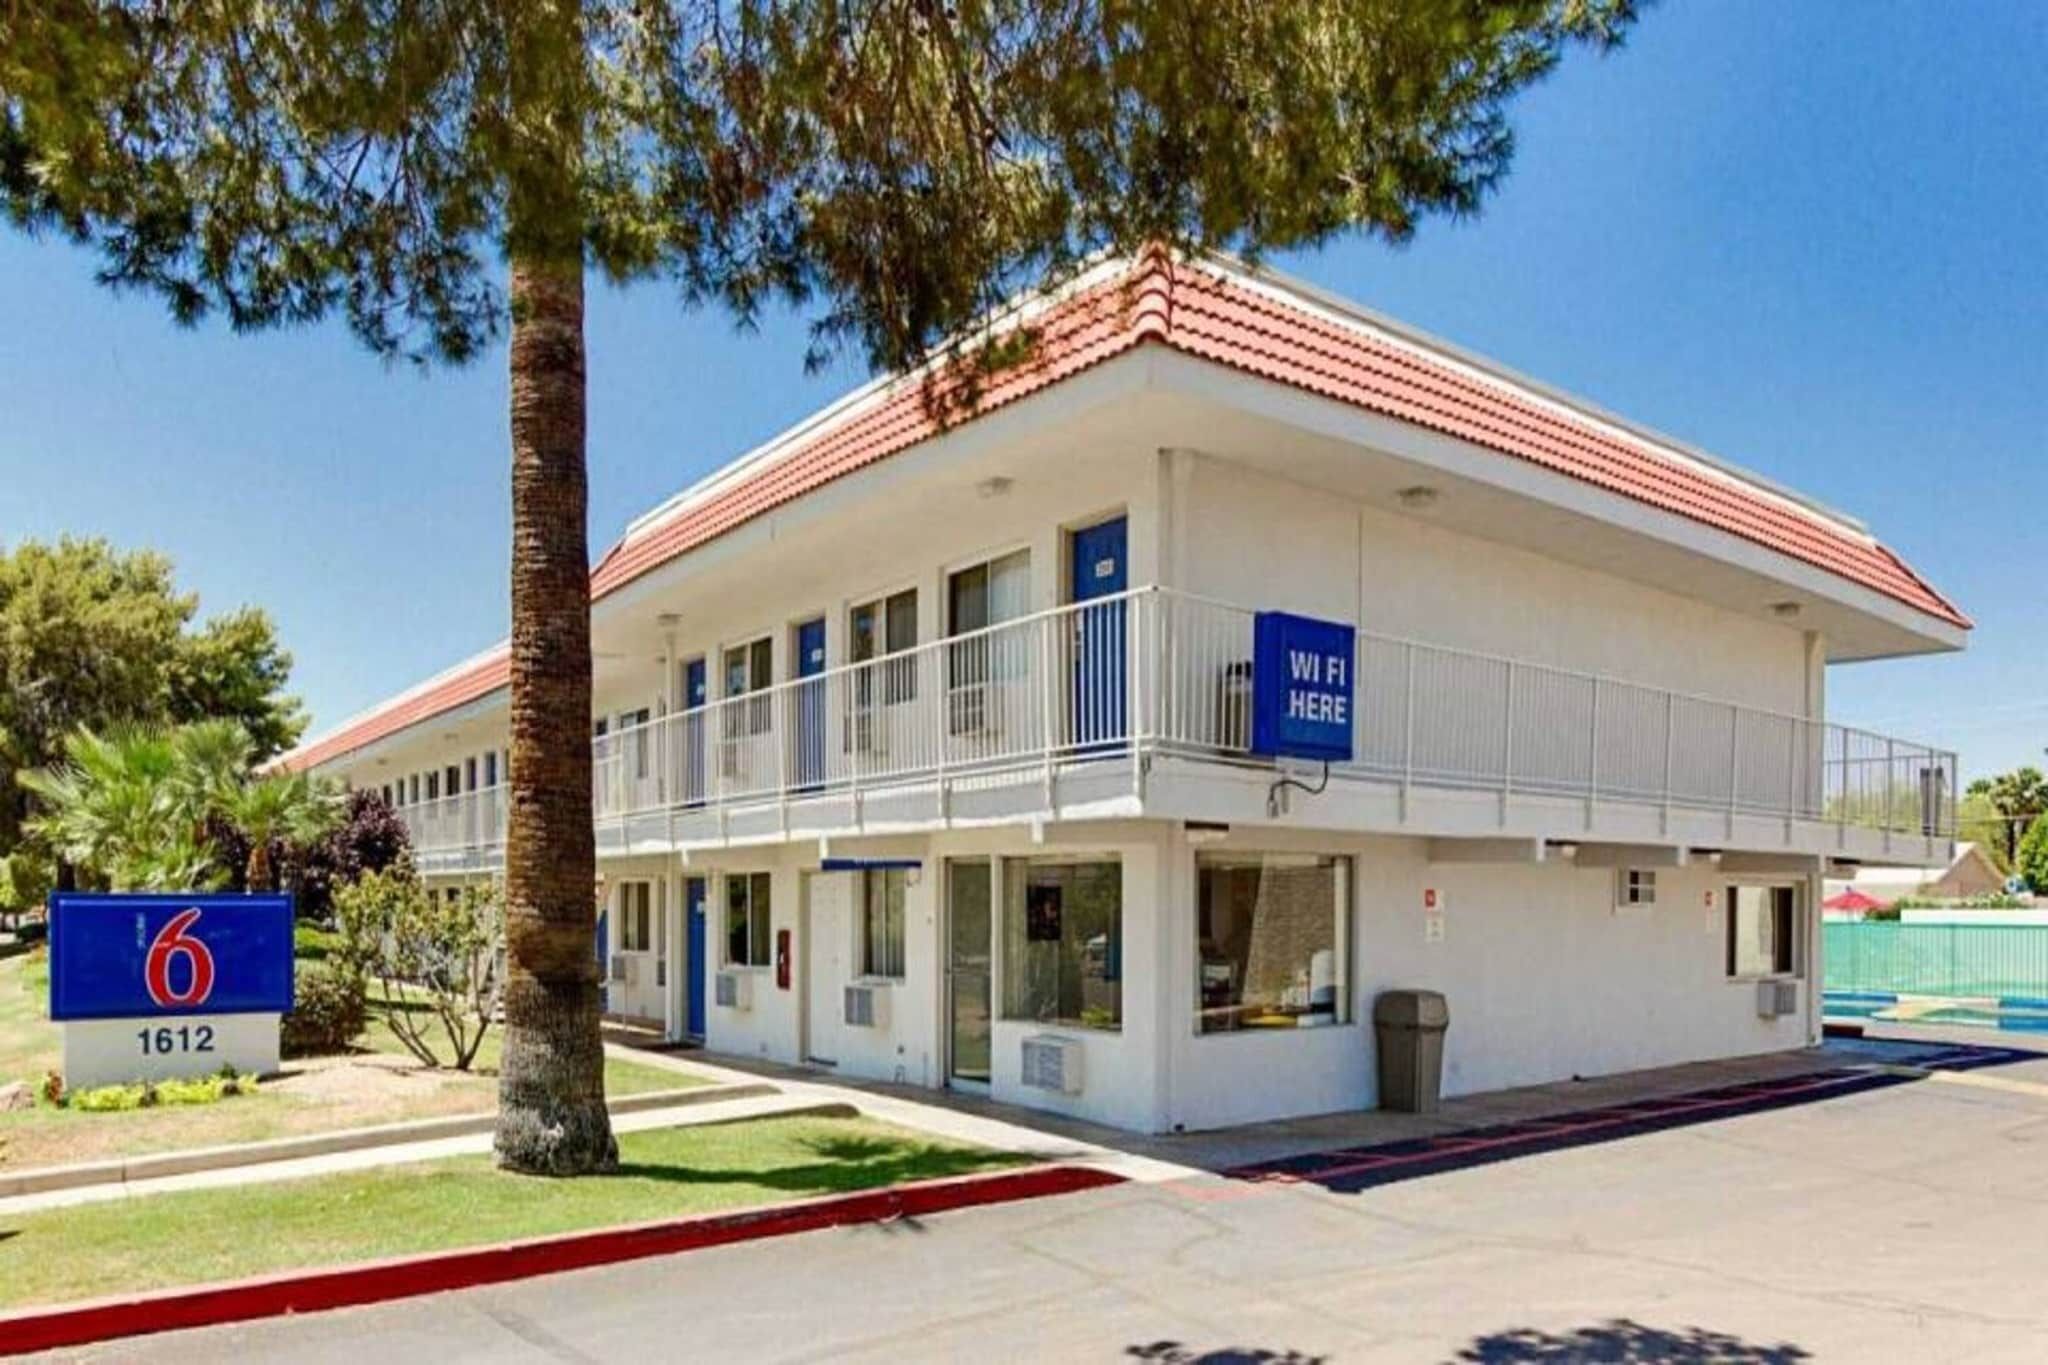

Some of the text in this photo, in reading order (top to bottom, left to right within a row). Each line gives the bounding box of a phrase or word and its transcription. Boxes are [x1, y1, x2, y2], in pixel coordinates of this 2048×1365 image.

[1290, 650, 1346, 686] WI FI
[1289, 689, 1347, 724] HERE
[146, 908, 214, 1007] 6
[138, 1026, 214, 1055] 1612
